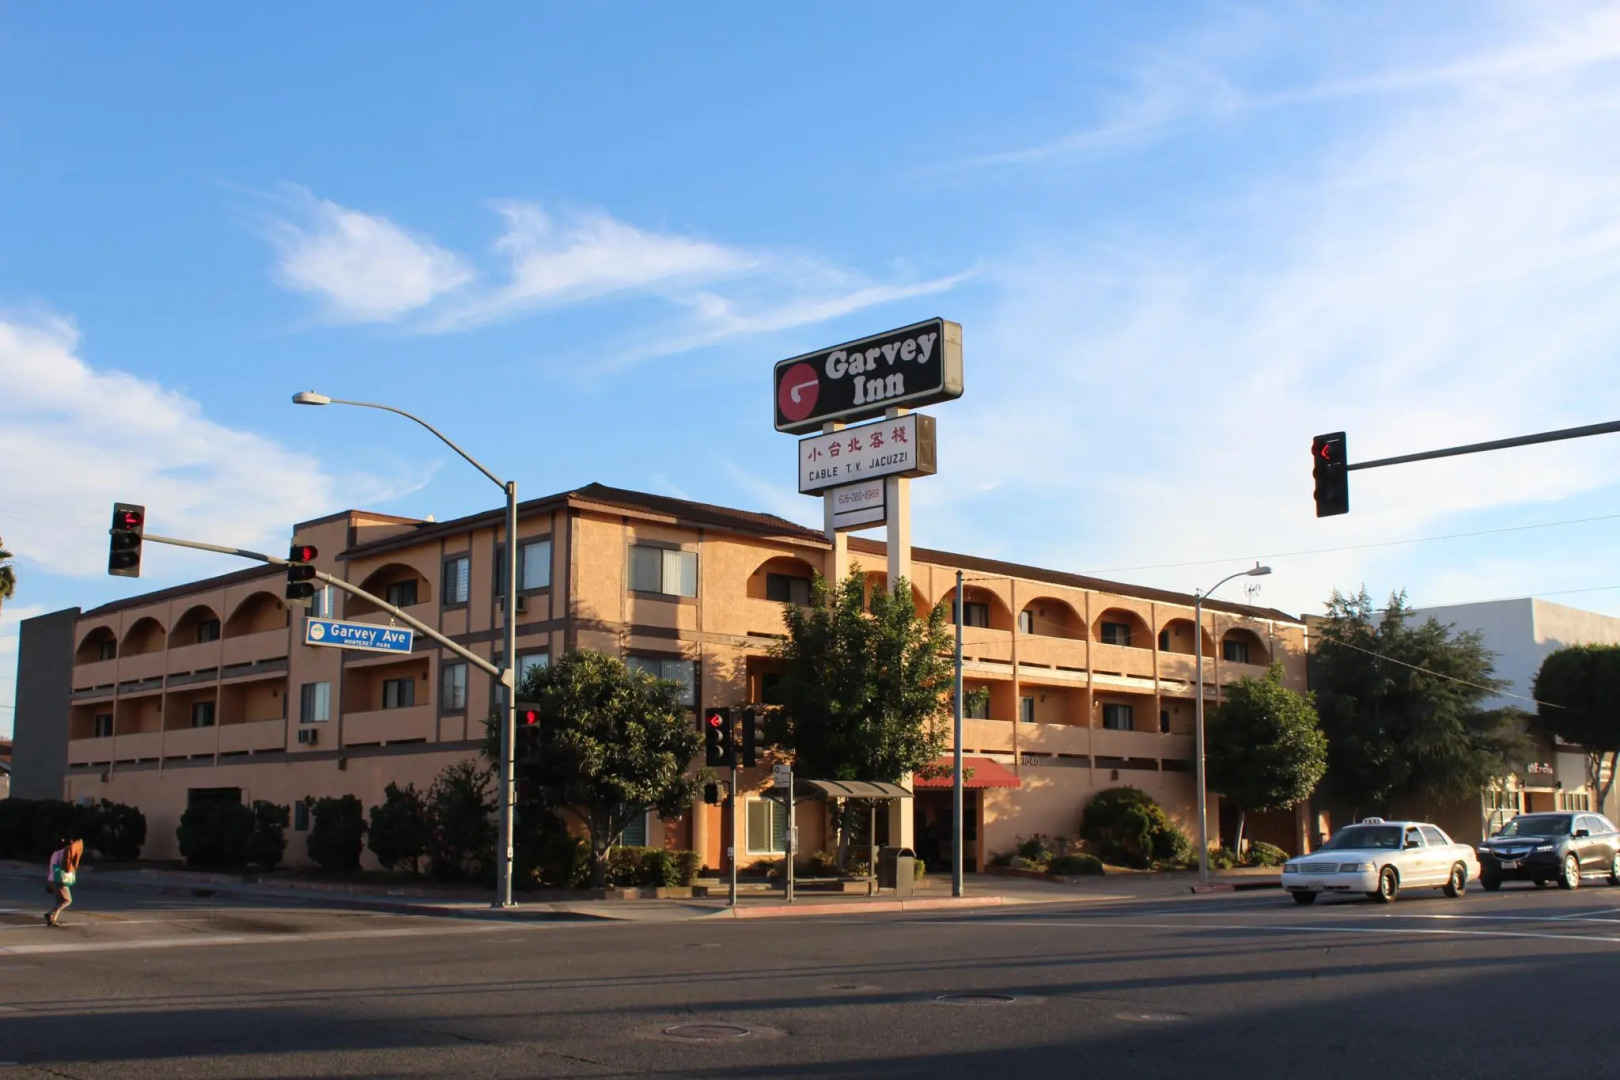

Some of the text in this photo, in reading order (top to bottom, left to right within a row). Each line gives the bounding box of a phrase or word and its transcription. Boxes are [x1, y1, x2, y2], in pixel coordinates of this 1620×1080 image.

[825, 332, 937, 379] Garvey
[853, 372, 905, 405] Inn
[809, 466, 838, 481] CABLE
[869, 451, 908, 469] JACUZZI
[330, 624, 406, 643] Garvey Ave
[344, 638, 373, 647] MONTEREY
[1022, 755, 1040, 766] 1040
